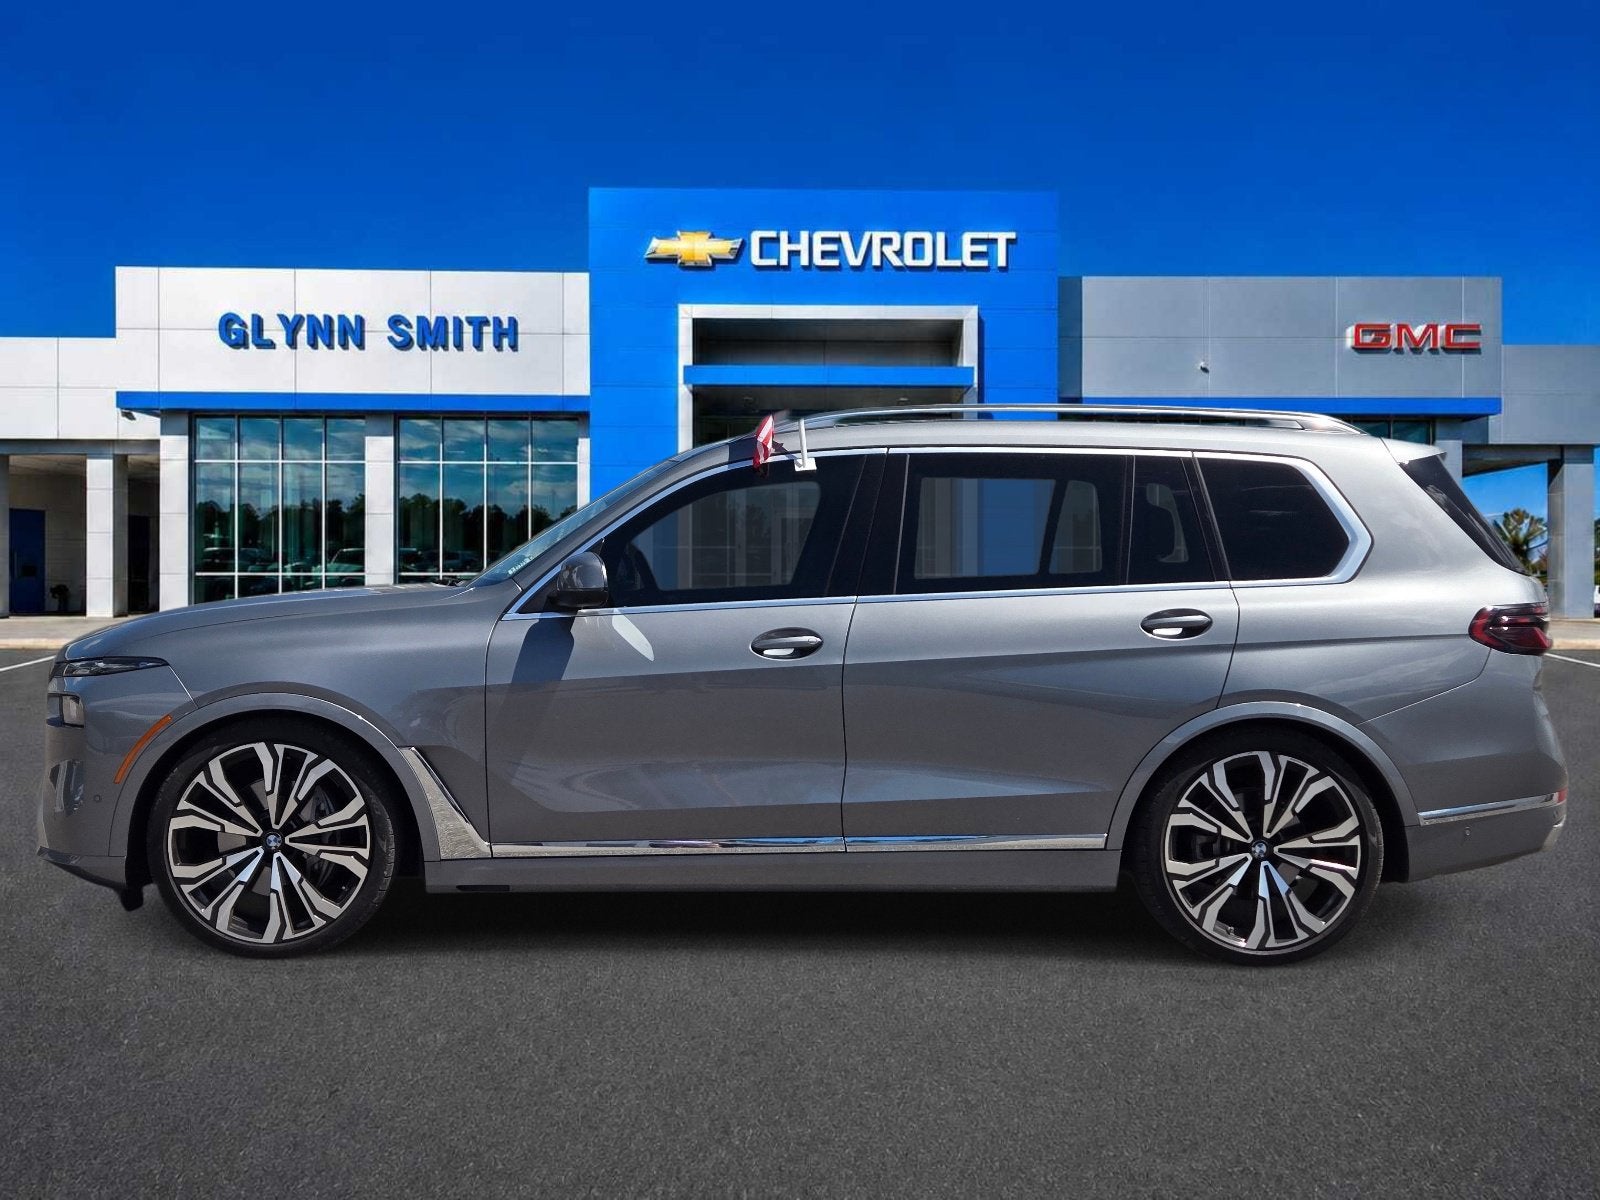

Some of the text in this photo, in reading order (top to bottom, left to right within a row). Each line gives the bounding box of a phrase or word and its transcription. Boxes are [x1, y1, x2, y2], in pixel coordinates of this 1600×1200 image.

[750, 230, 1017, 268] CHEVROLET
[218, 312, 519, 352] GLYNN SMITH
[1352, 322, 1481, 350] GMC
